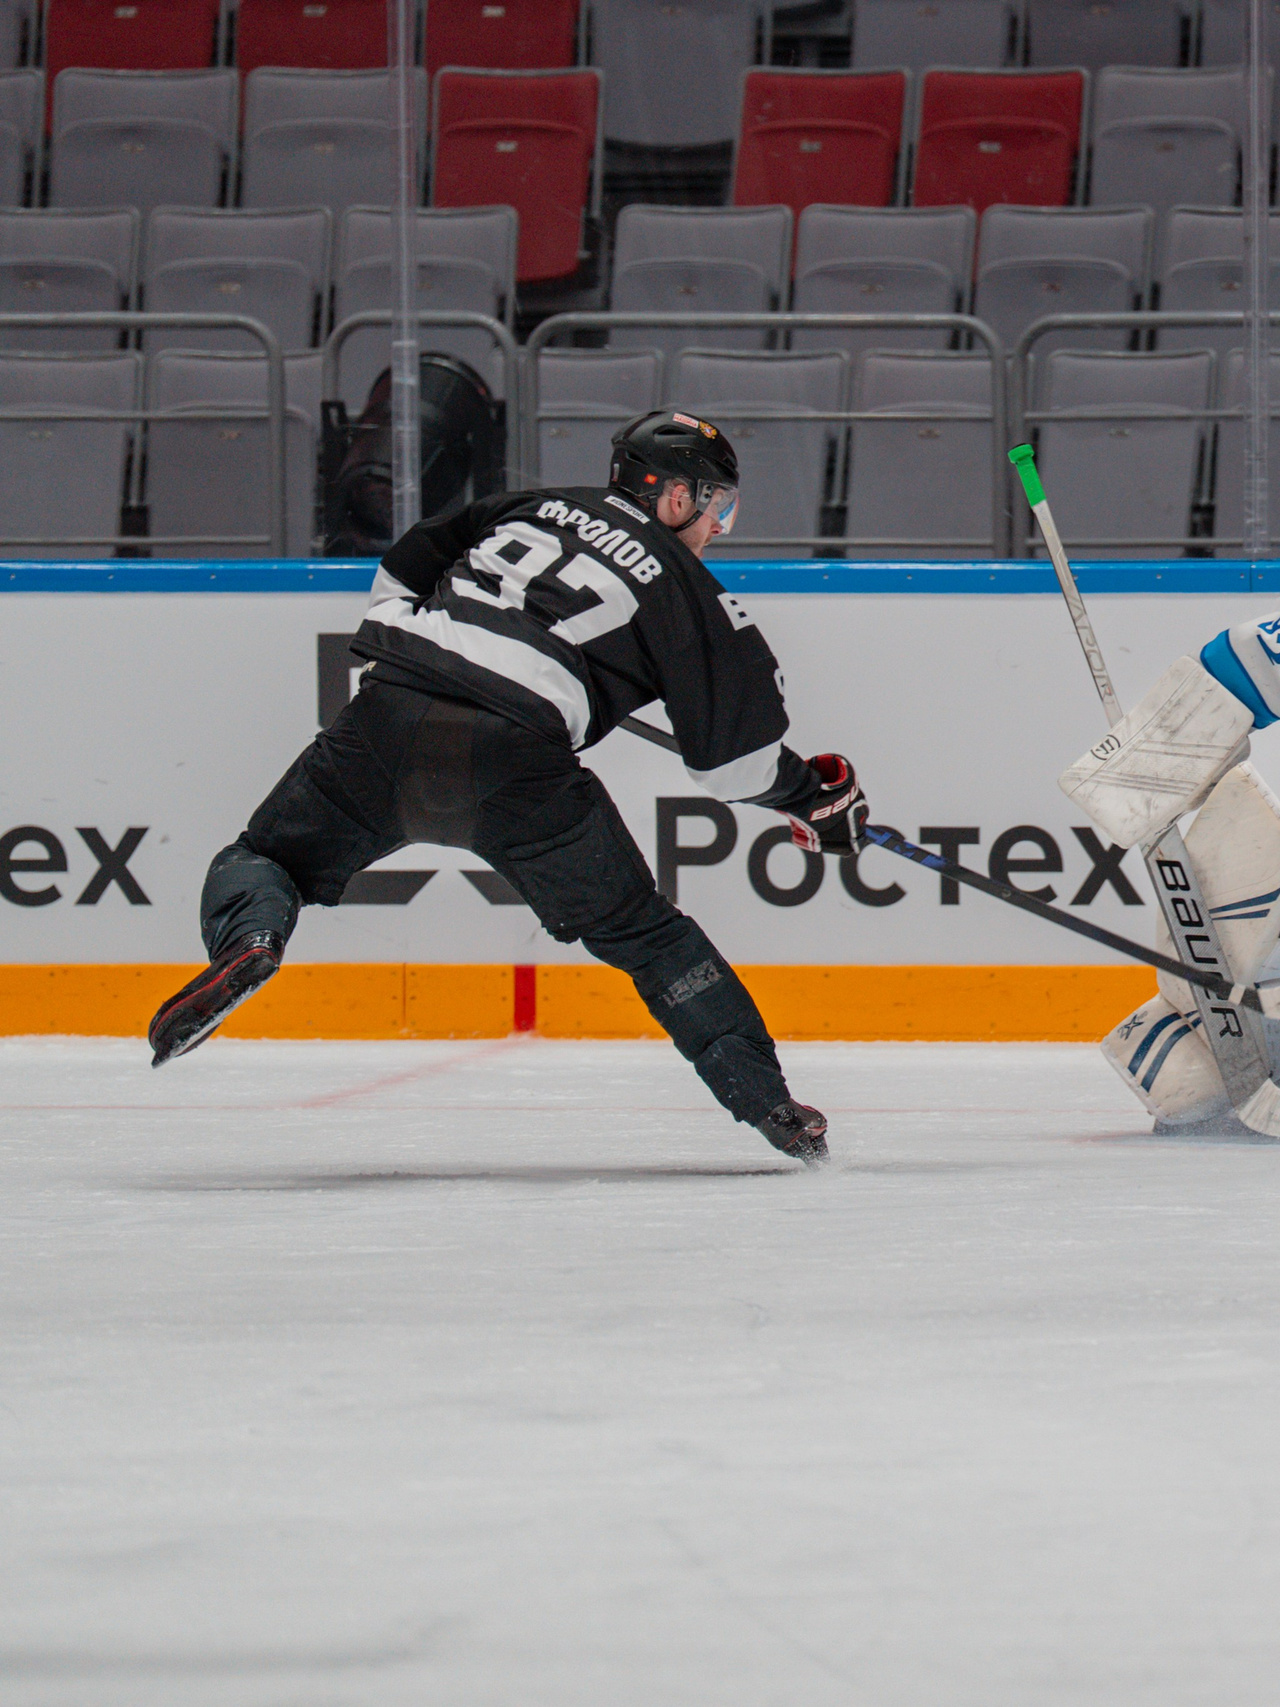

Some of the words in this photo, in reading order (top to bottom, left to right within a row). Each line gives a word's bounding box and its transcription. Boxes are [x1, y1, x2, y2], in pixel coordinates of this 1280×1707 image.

[451, 521, 640, 646] 97
[536, 500, 662, 584] ФРОЛОВ
[655, 796, 1146, 907] Ростех
